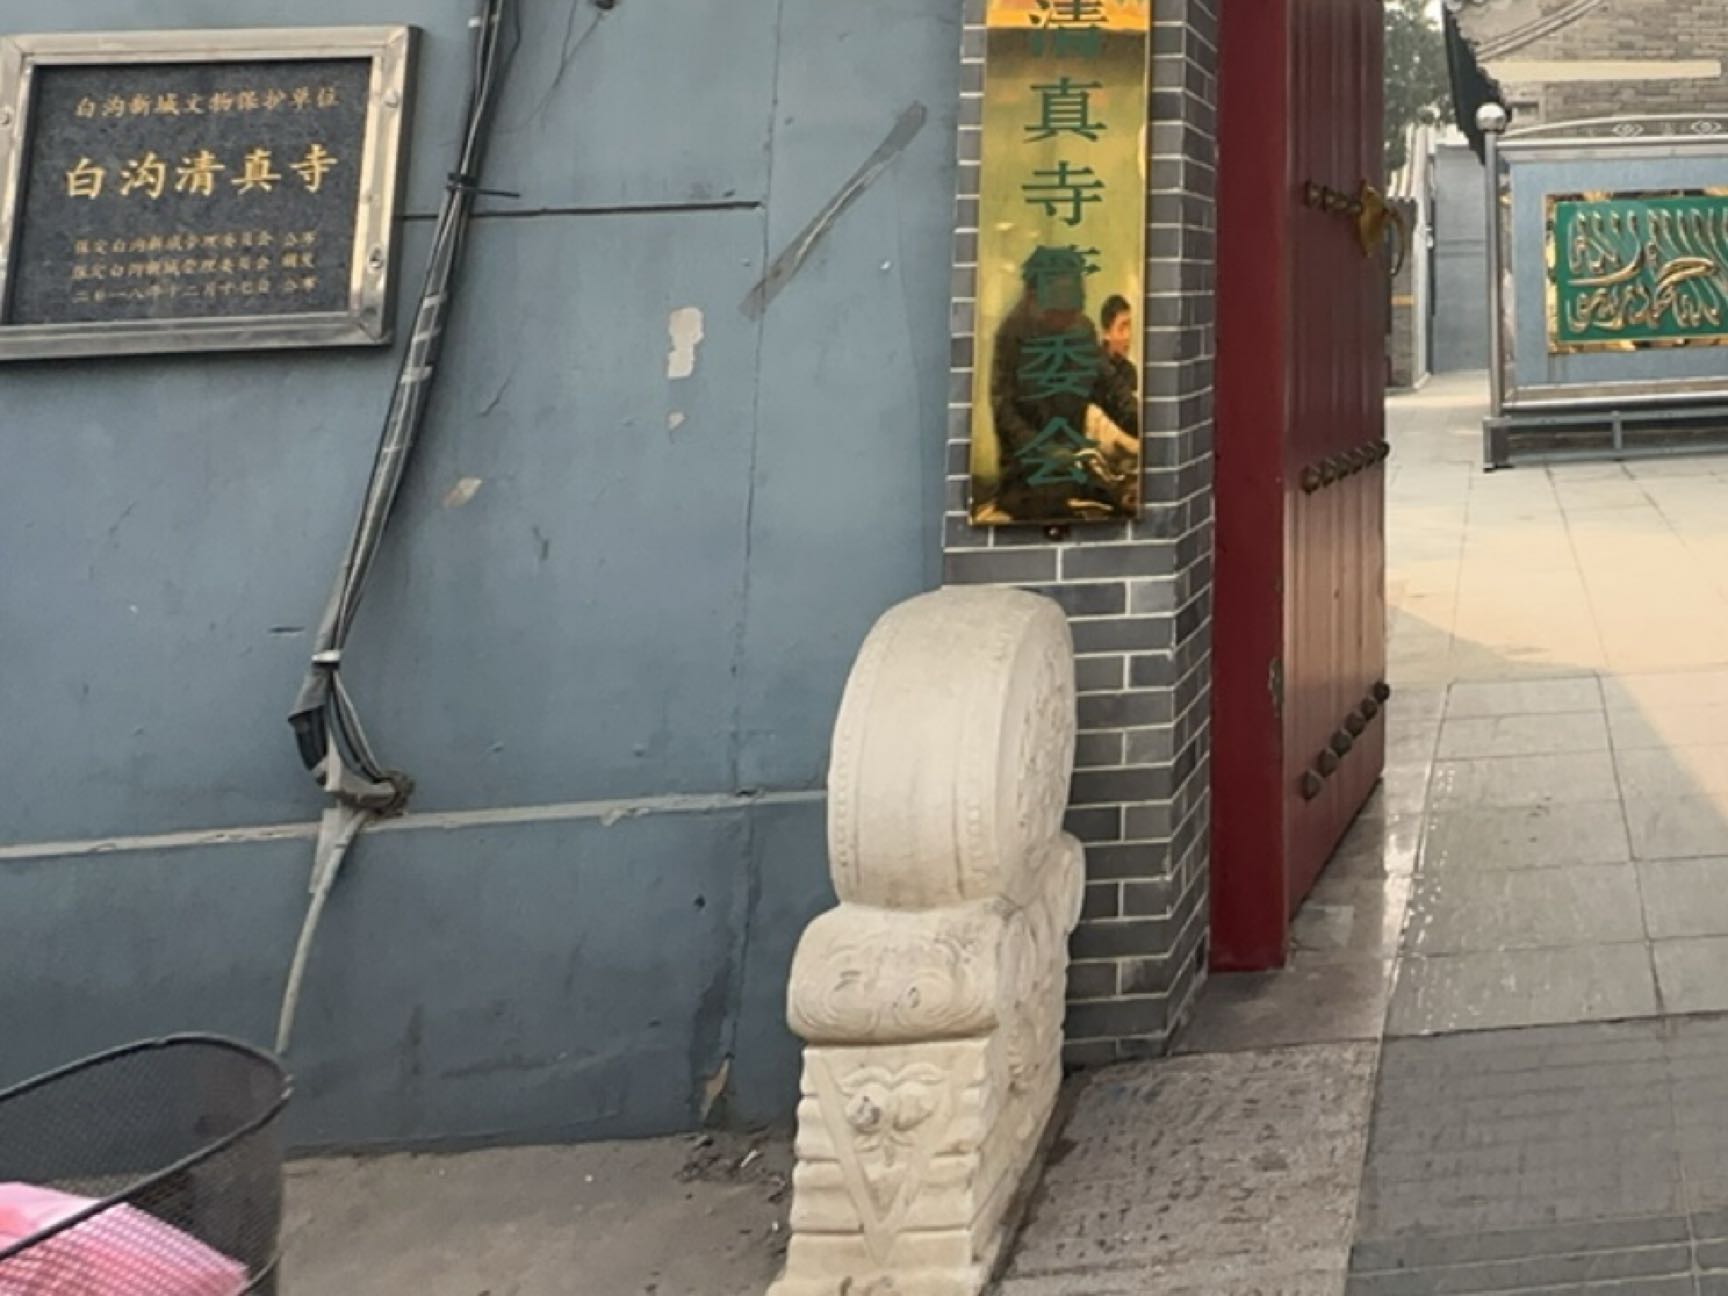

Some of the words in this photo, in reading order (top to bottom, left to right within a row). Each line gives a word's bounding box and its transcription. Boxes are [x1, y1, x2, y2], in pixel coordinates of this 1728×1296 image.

[64, 143, 339, 201] 白沟清真寺
